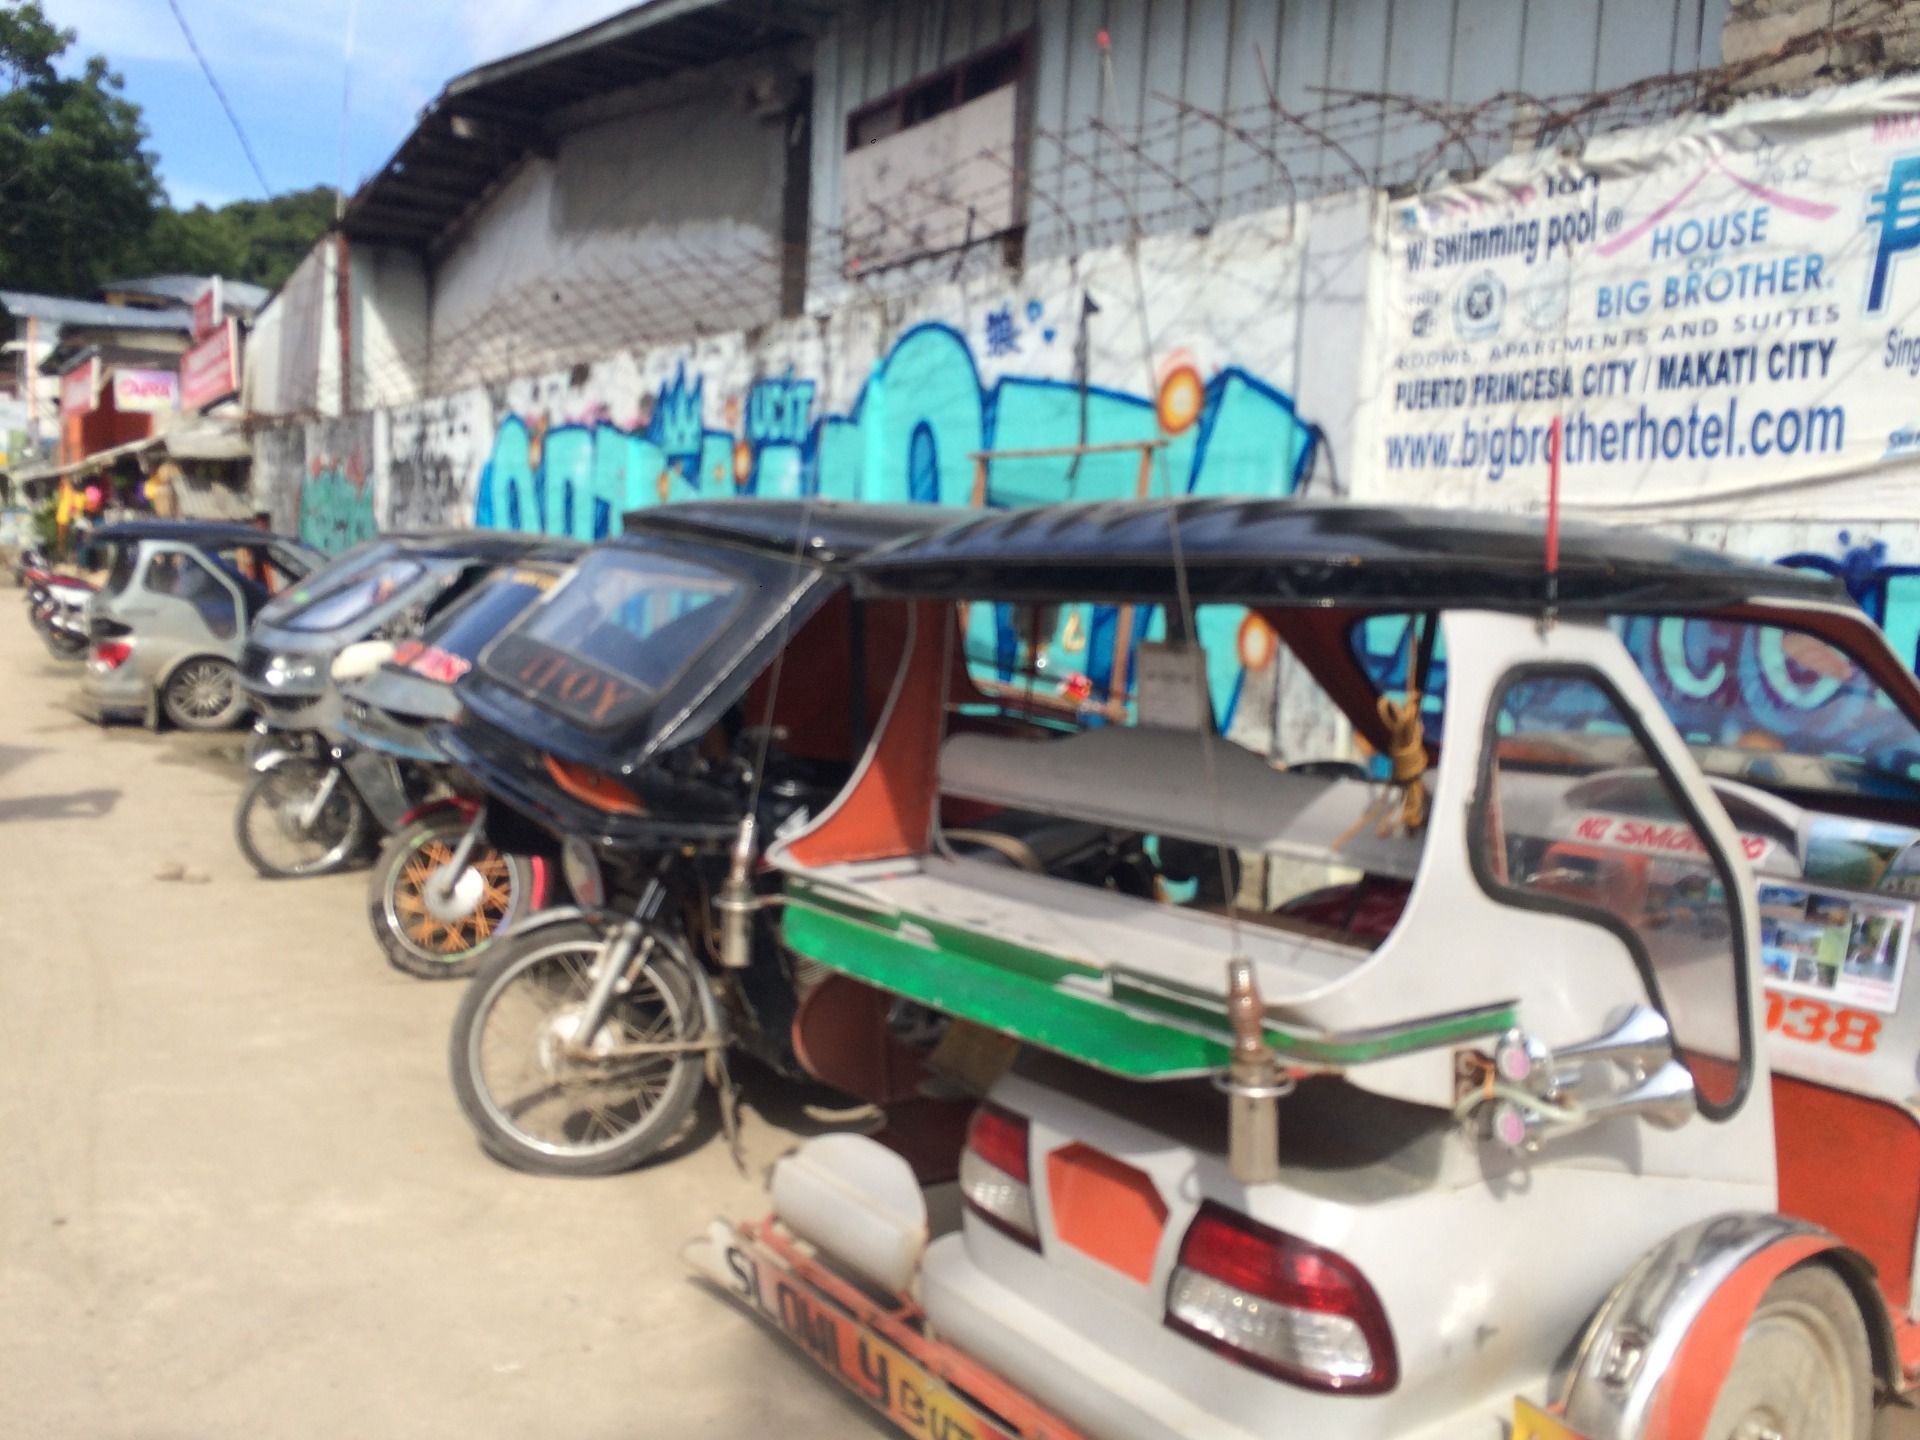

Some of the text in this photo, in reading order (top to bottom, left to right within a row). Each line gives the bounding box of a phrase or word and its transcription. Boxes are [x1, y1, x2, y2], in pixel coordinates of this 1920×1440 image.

[1433, 212, 1540, 268] swimming
[1547, 196, 1598, 261] pool
[1604, 207, 1624, 234] @
[1651, 206, 1770, 258] HOUSE
[1597, 280, 1652, 319] BIG
[1489, 329, 1648, 362] APARTMENTS
[1661, 318, 1718, 341] AND
[1733, 305, 1840, 331] SUITES
[1396, 337, 1838, 410] PUERTO PRINCESA CITY / MAKATI CITY
[1577, 814, 1613, 842] NO
